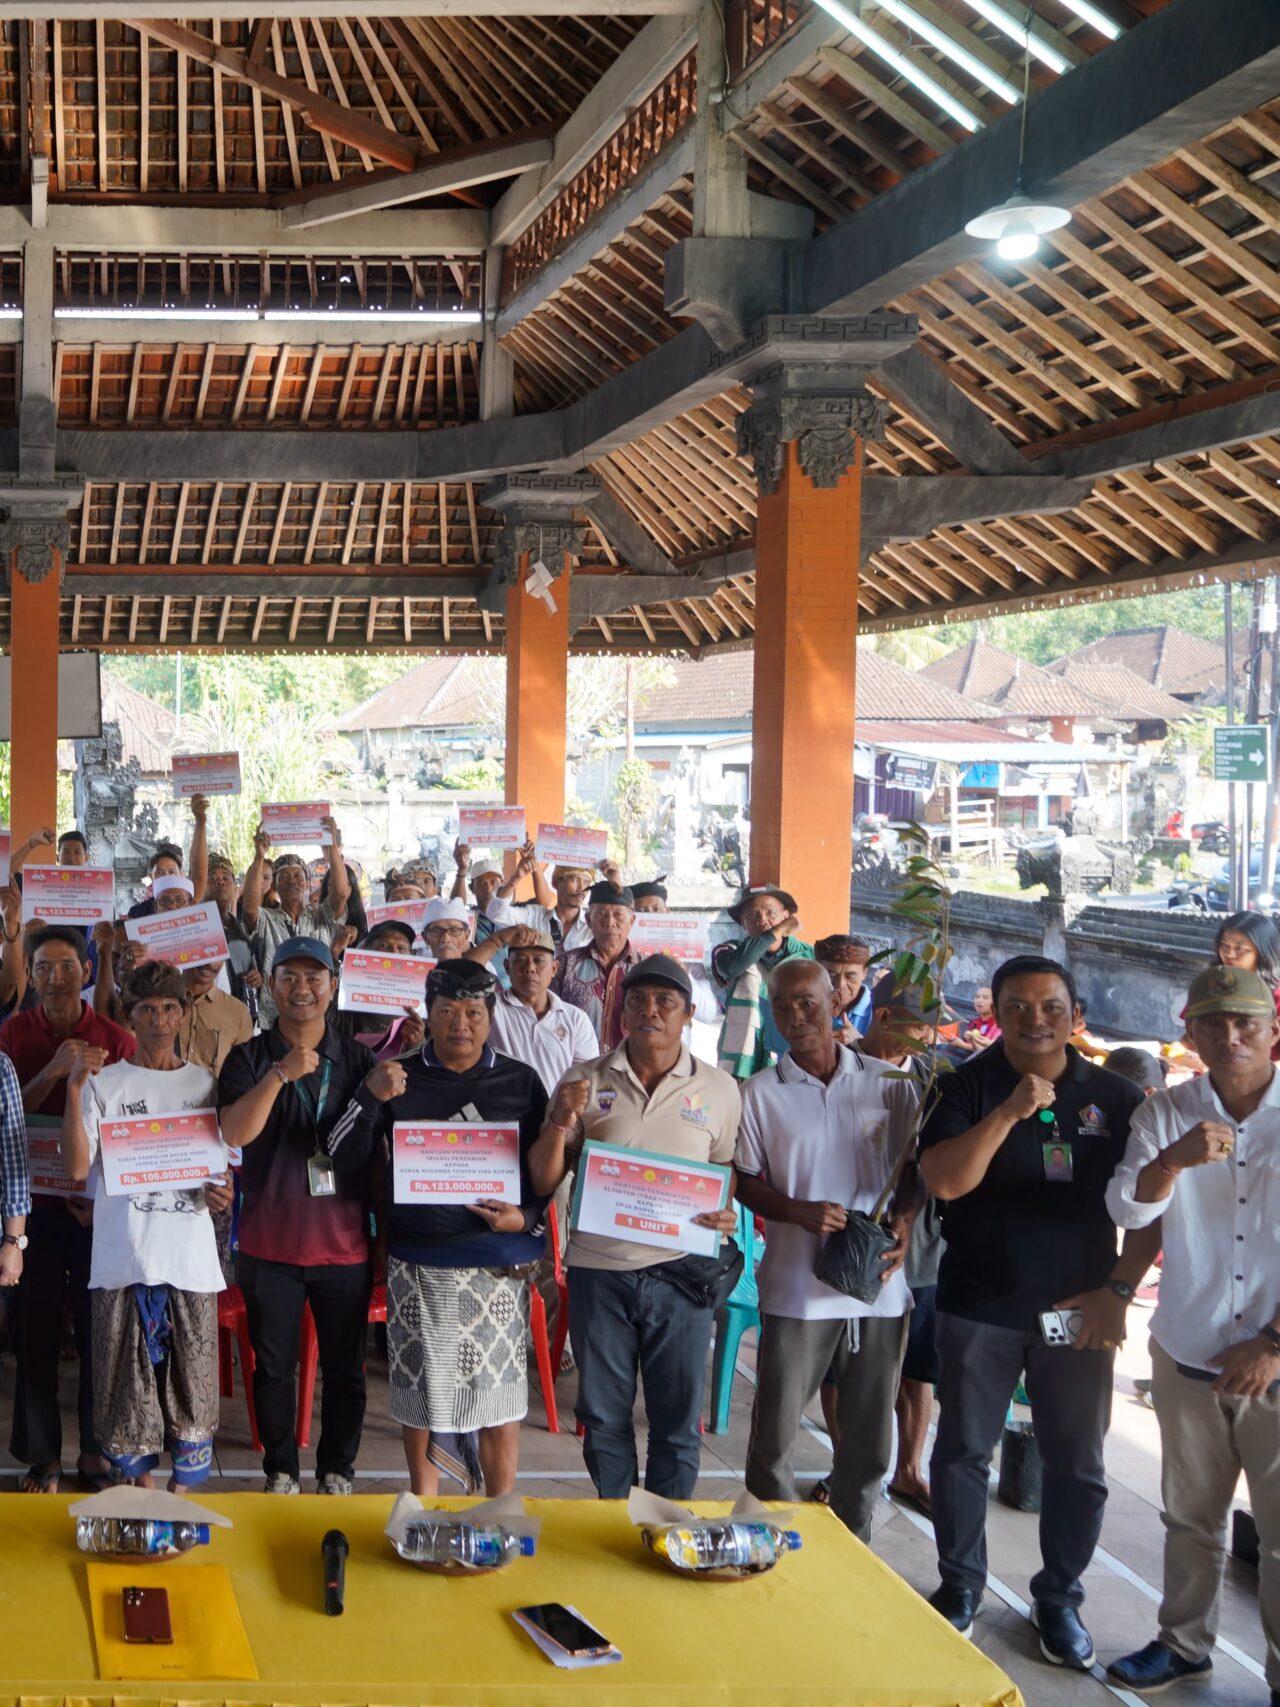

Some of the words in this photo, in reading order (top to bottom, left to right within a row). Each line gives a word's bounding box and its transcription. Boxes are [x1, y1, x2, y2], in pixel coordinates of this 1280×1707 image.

[124, 1174, 139, 1182] Rp.
[143, 1169, 207, 1181] 100.000.000,-
[54, 1180, 77, 1188] UNIT
[415, 1182, 500, 1192] Rp.123.000.000,-
[626, 1217, 632, 1225] 1
[639, 1219, 668, 1232] UNIT
